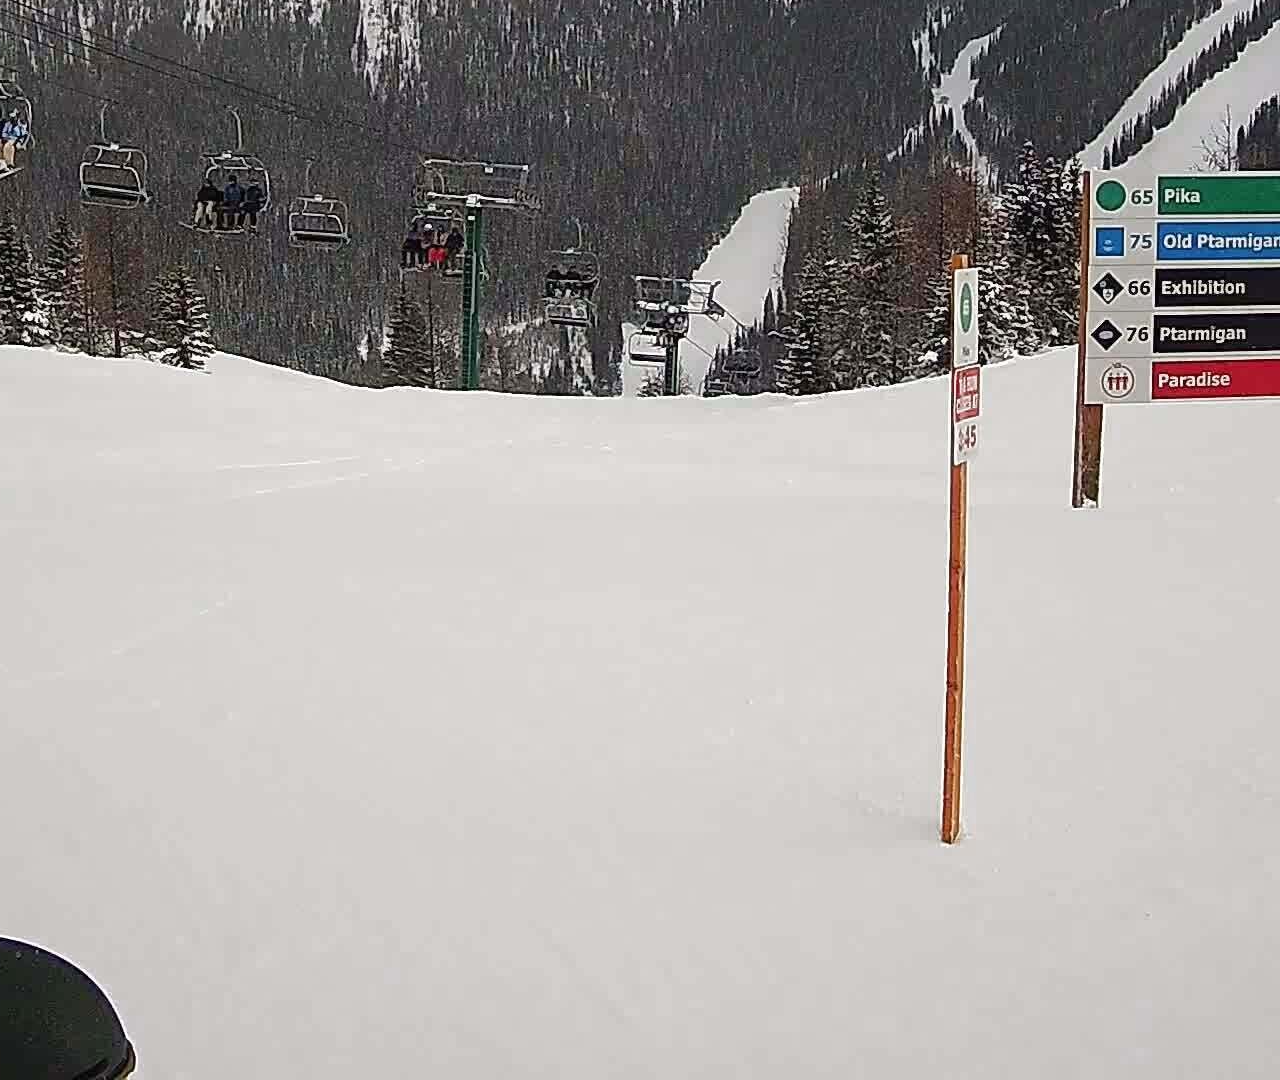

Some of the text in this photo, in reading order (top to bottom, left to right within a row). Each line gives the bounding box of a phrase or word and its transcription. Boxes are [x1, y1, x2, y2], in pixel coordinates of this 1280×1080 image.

[1131, 187, 1201, 205] 65 Pika
[1130, 234, 1152, 249] 75
[1163, 233, 1192, 249] Old
[1128, 279, 1246, 296] 66 Exhibition
[1126, 325, 1247, 344] 76 Ptarmigan
[1158, 371, 1231, 388] Paradise
